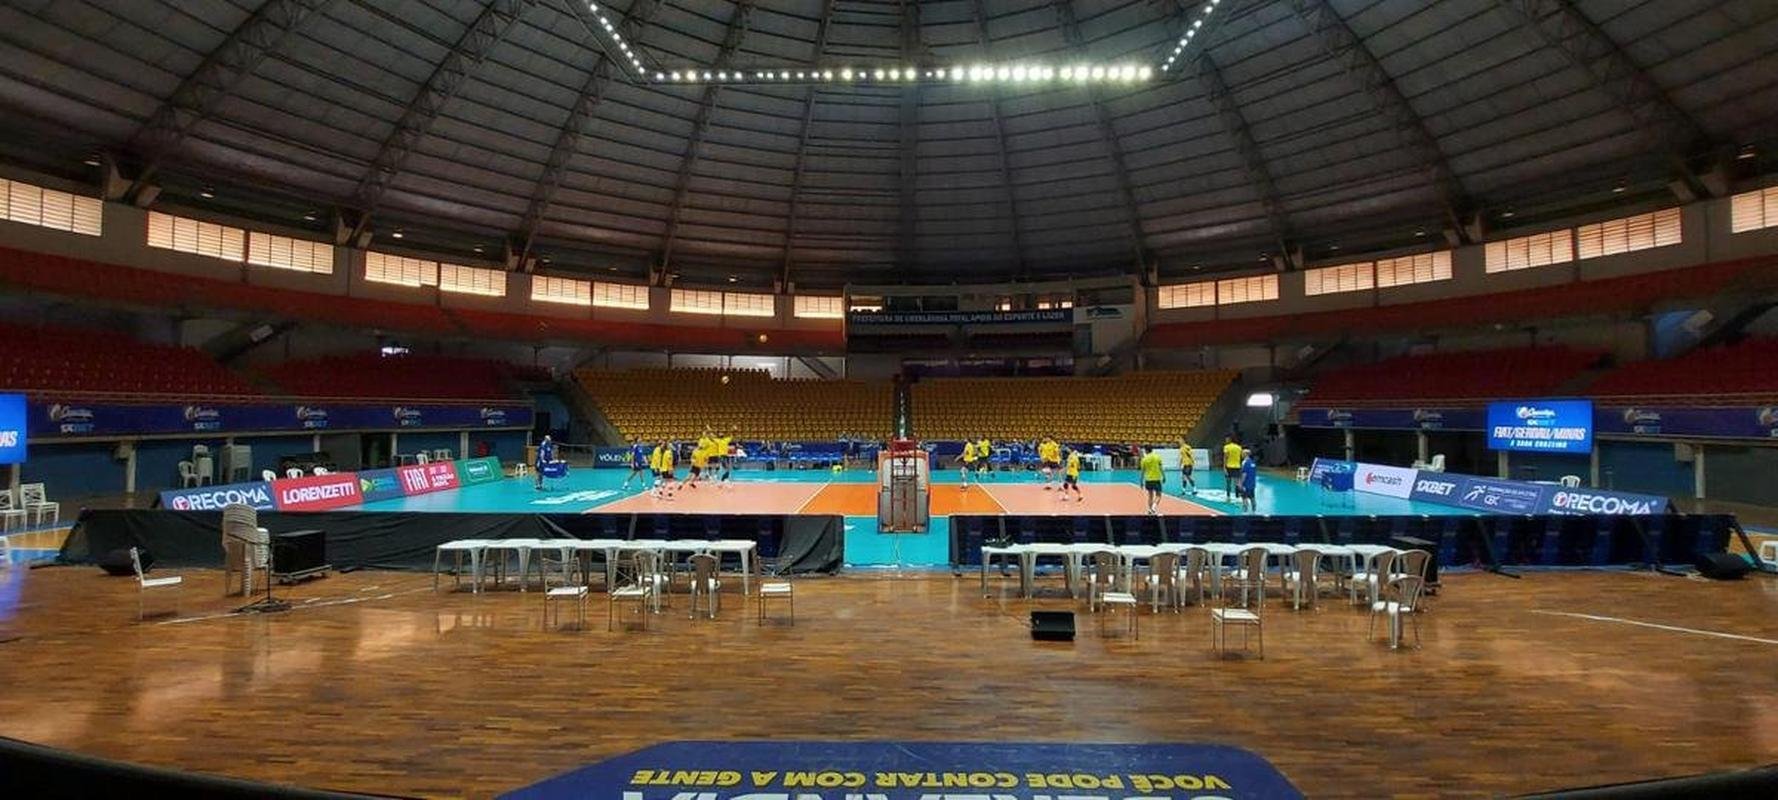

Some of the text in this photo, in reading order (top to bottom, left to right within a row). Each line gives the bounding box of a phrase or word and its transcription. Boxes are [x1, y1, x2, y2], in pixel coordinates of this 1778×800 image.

[403, 468, 430, 492] FIAT
[188, 488, 270, 511] RECOMA
[282, 482, 355, 504] LORENZETTI
[1566, 492, 1651, 515] RECOMA
[630, 769, 1231, 793] VOCÊ PODE CONTAR COM A GENTE
